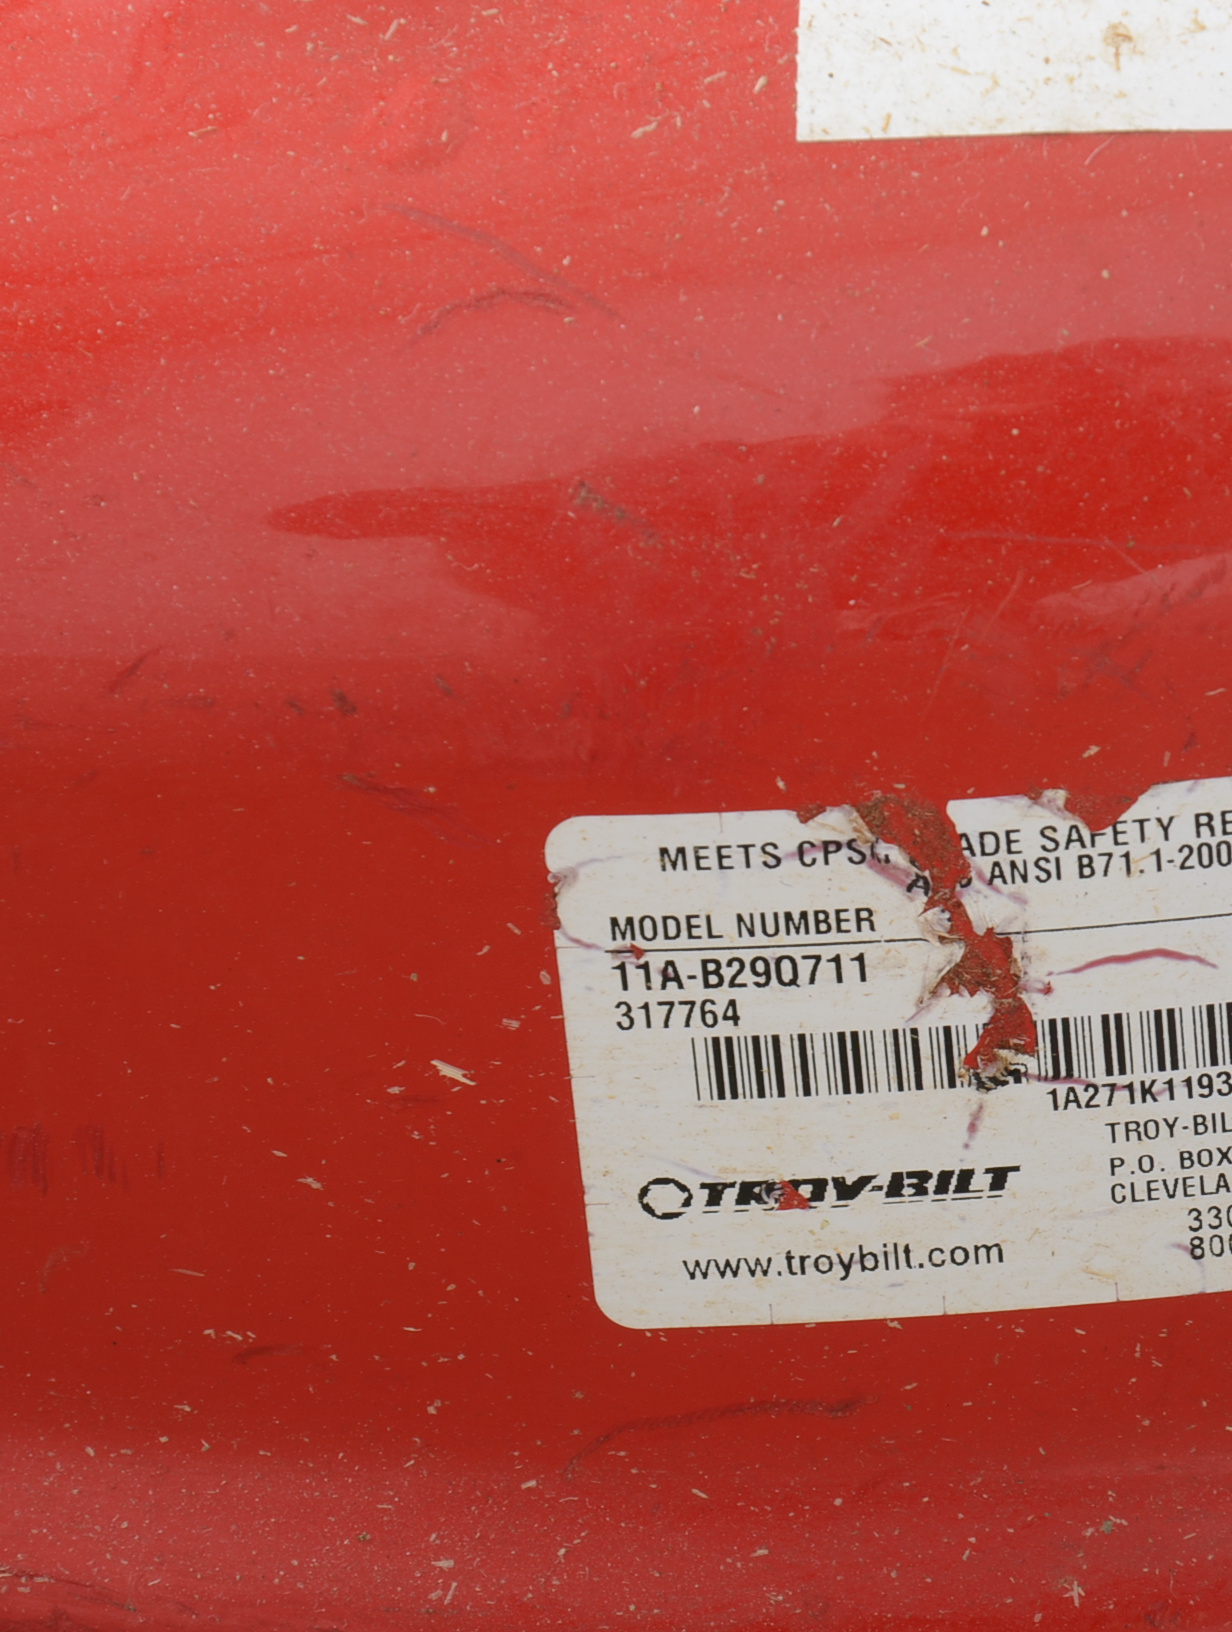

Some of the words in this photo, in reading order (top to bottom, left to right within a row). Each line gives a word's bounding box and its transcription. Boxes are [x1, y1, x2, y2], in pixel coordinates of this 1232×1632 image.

[658, 842, 784, 873] MEETS
[1039, 816, 1176, 853] SAFETY
[987, 856, 1062, 886] ANSI
[609, 913, 724, 942] MODEL
[736, 907, 876, 939] NUMBER
[611, 953, 868, 991] 11A-B29Q711
[615, 999, 741, 1031] 317764
[1109, 1155, 1166, 1177] P.O.
[699, 1165, 1022, 1211] TROY-BILT
[682, 1242, 1004, 1281] www.troybilt.com
